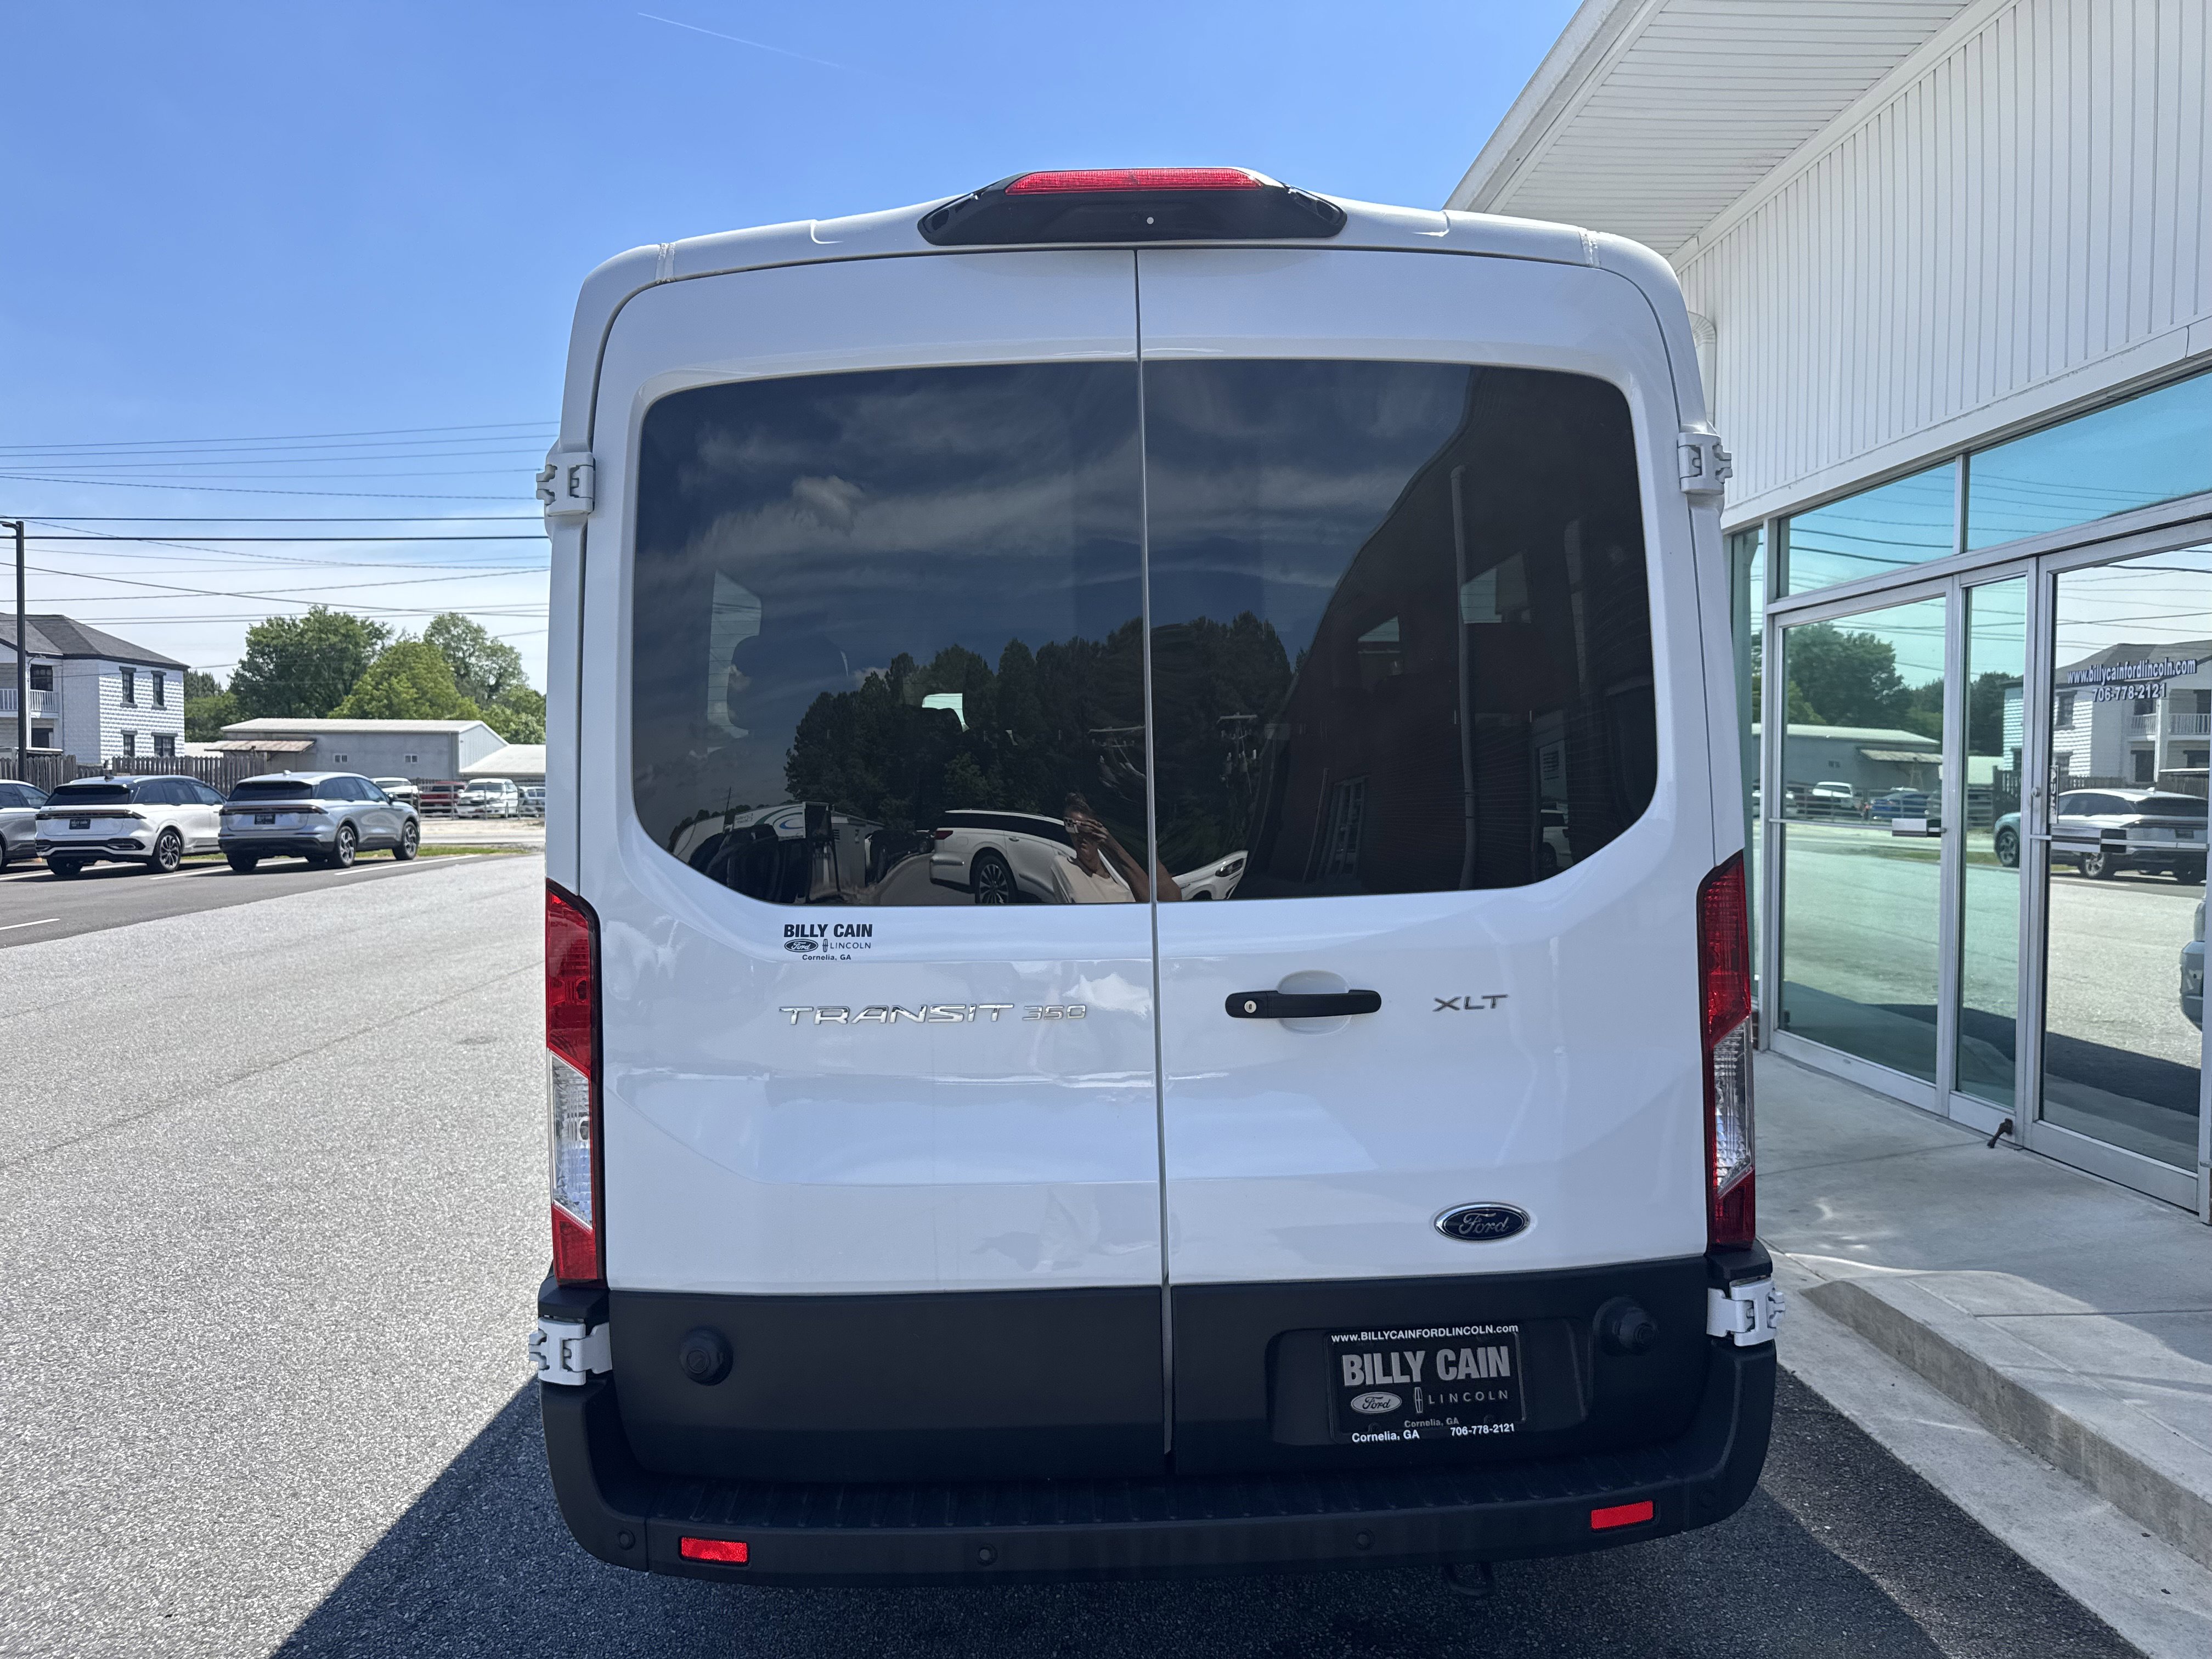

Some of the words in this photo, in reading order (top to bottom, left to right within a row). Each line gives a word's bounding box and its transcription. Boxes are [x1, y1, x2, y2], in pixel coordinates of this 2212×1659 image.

[2067, 657, 2197, 686] www.billycainfordlincoln.com
[2093, 682, 2166, 702] 706-778-2121
[784, 924, 828, 938] BILLY
[833, 924, 873, 938] CAIN
[1432, 994, 1509, 1012] XLT
[778, 1003, 1014, 1024] TRANSIT
[1022, 1005, 1087, 1020] 350
[1331, 1325, 1519, 1343] www.BILLYCAINFORDLINCOLN.com
[1342, 1350, 1426, 1386] BILLY
[1436, 1346, 1511, 1381] CAIN
[1429, 1390, 1509, 1404] LINCOLN
[1404, 1418, 1443, 1428] Cornelia,
[1450, 1423, 1515, 1437] 706-778-2121
[1352, 1431, 1400, 1443] Cornelia,
[1403, 1429, 1420, 1440] GA
